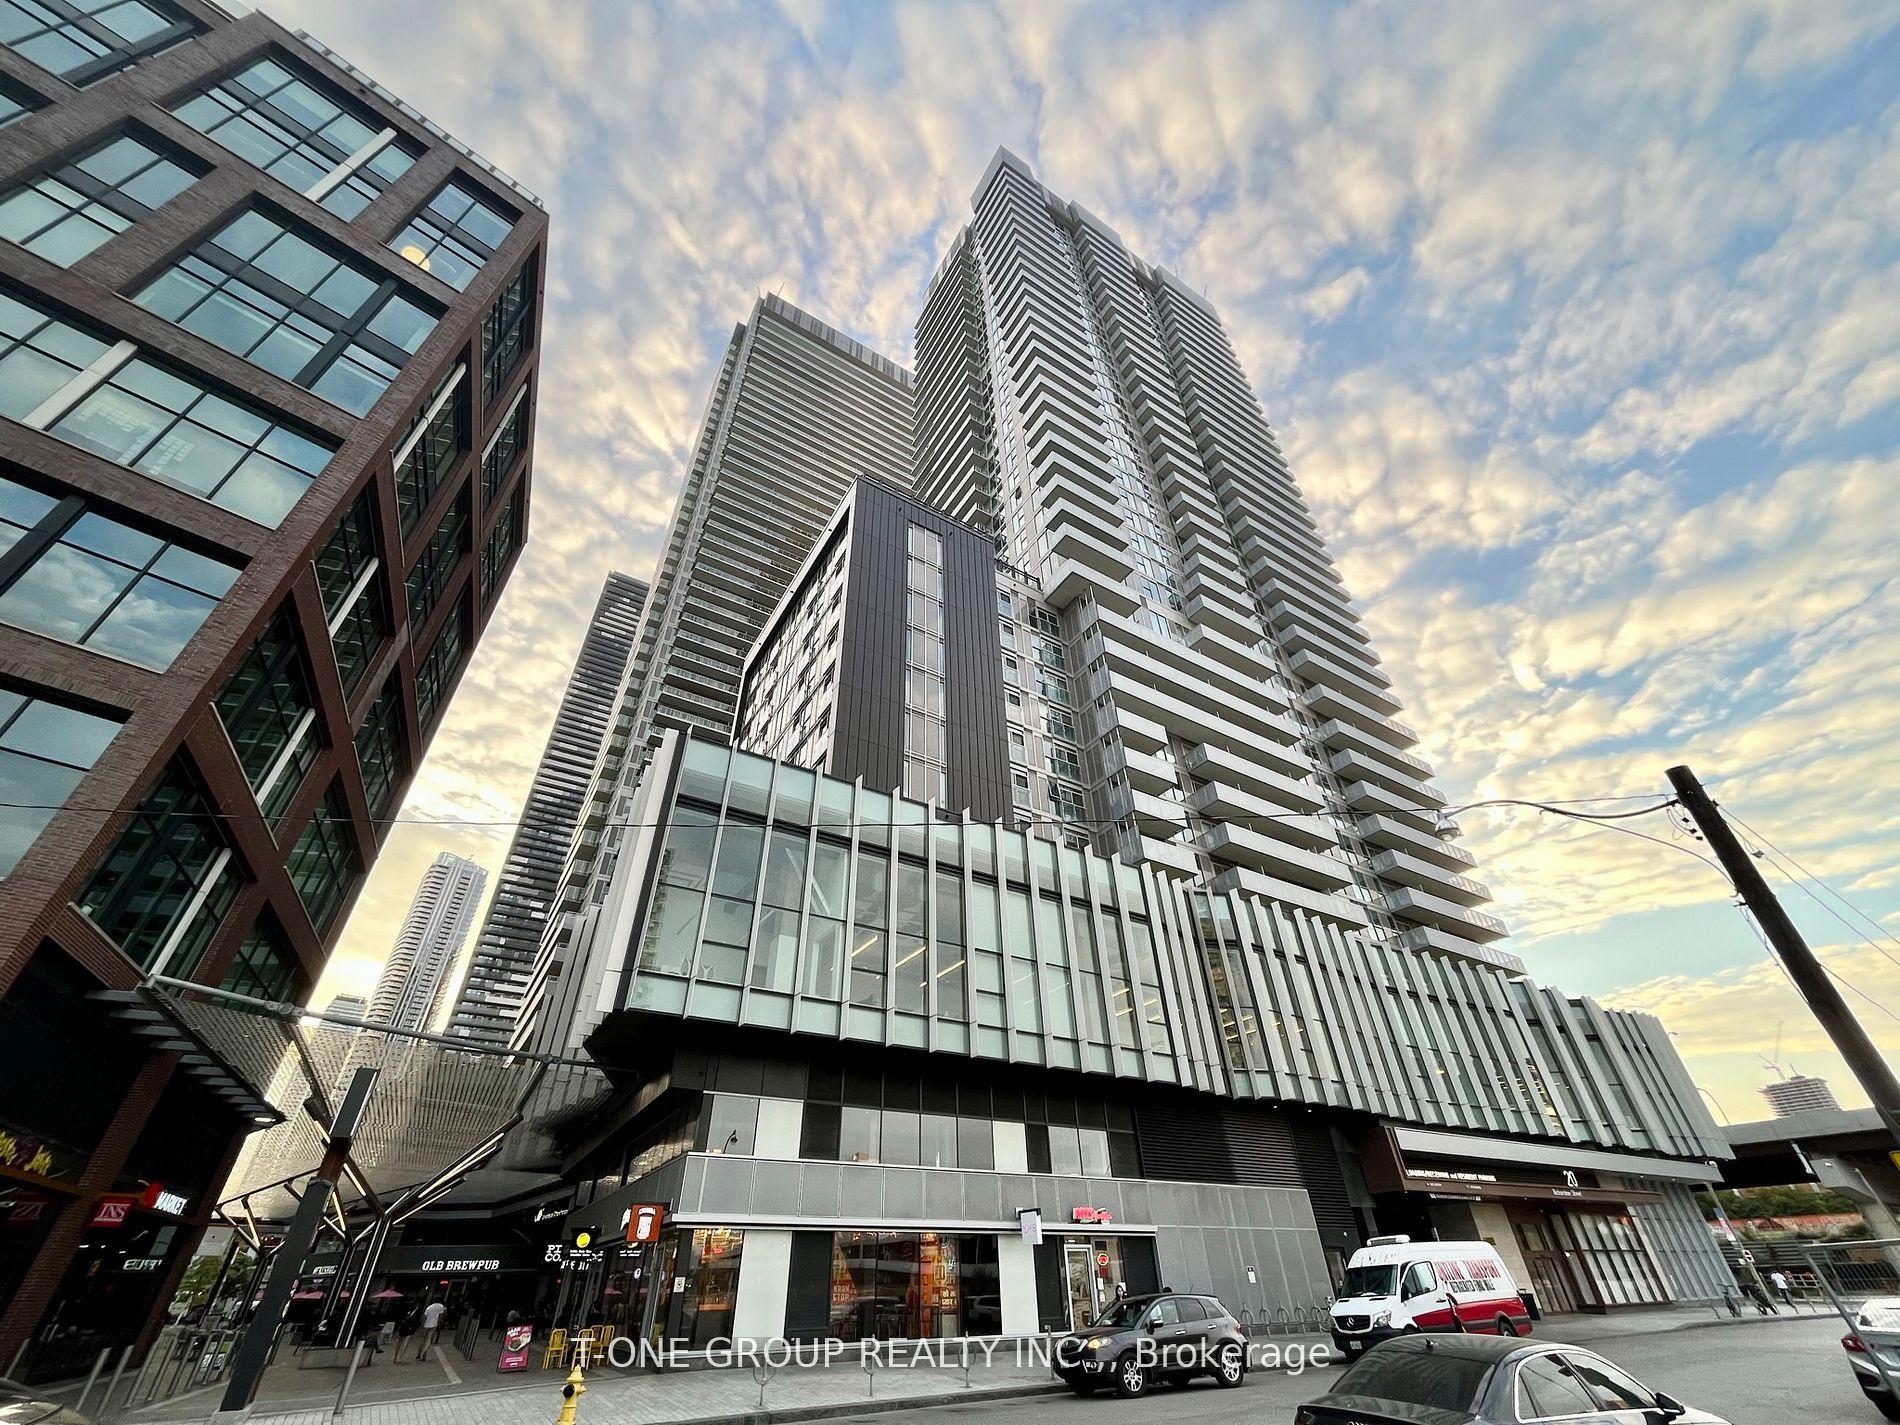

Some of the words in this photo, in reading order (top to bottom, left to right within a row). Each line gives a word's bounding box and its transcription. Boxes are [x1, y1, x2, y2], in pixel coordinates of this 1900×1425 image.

[1562, 1170, 1579, 1188] 20
[153, 1190, 188, 1216] MARKET
[546, 1244, 563, 1253] PI
[544, 1253, 562, 1262] CO.
[445, 1259, 500, 1271] BREWPUB
